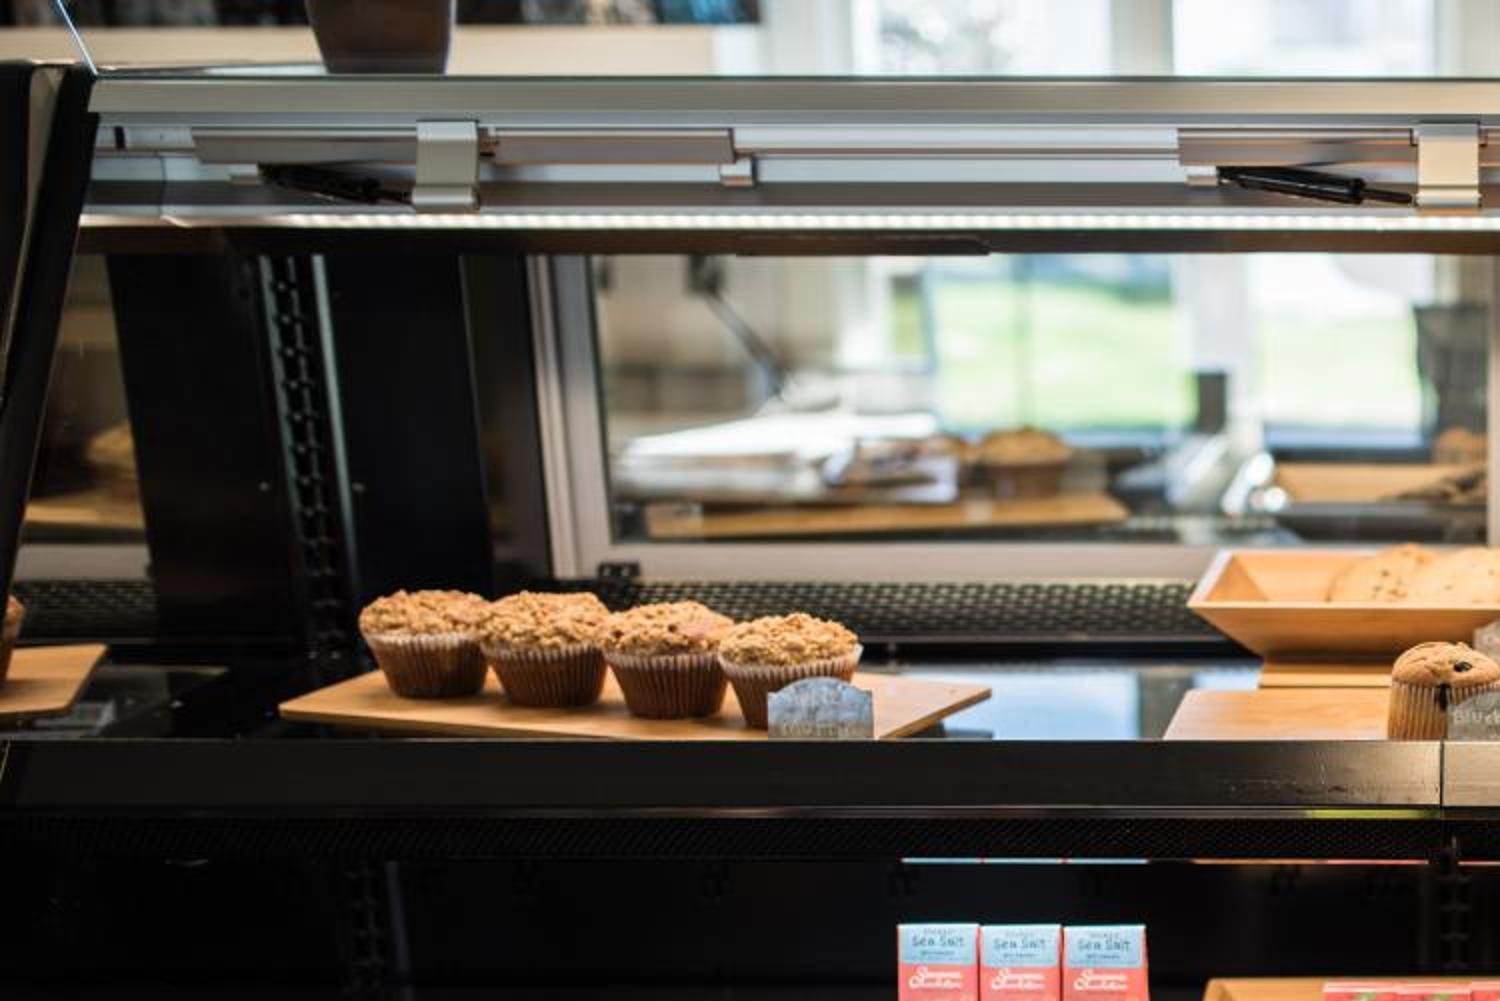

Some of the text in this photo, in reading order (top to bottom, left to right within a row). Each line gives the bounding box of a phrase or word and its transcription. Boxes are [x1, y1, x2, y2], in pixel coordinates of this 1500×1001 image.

[911, 935, 965, 948] Sea Salt
[993, 937, 1046, 950] Sea Salt
[1076, 938, 1131, 951] Sea Salt
